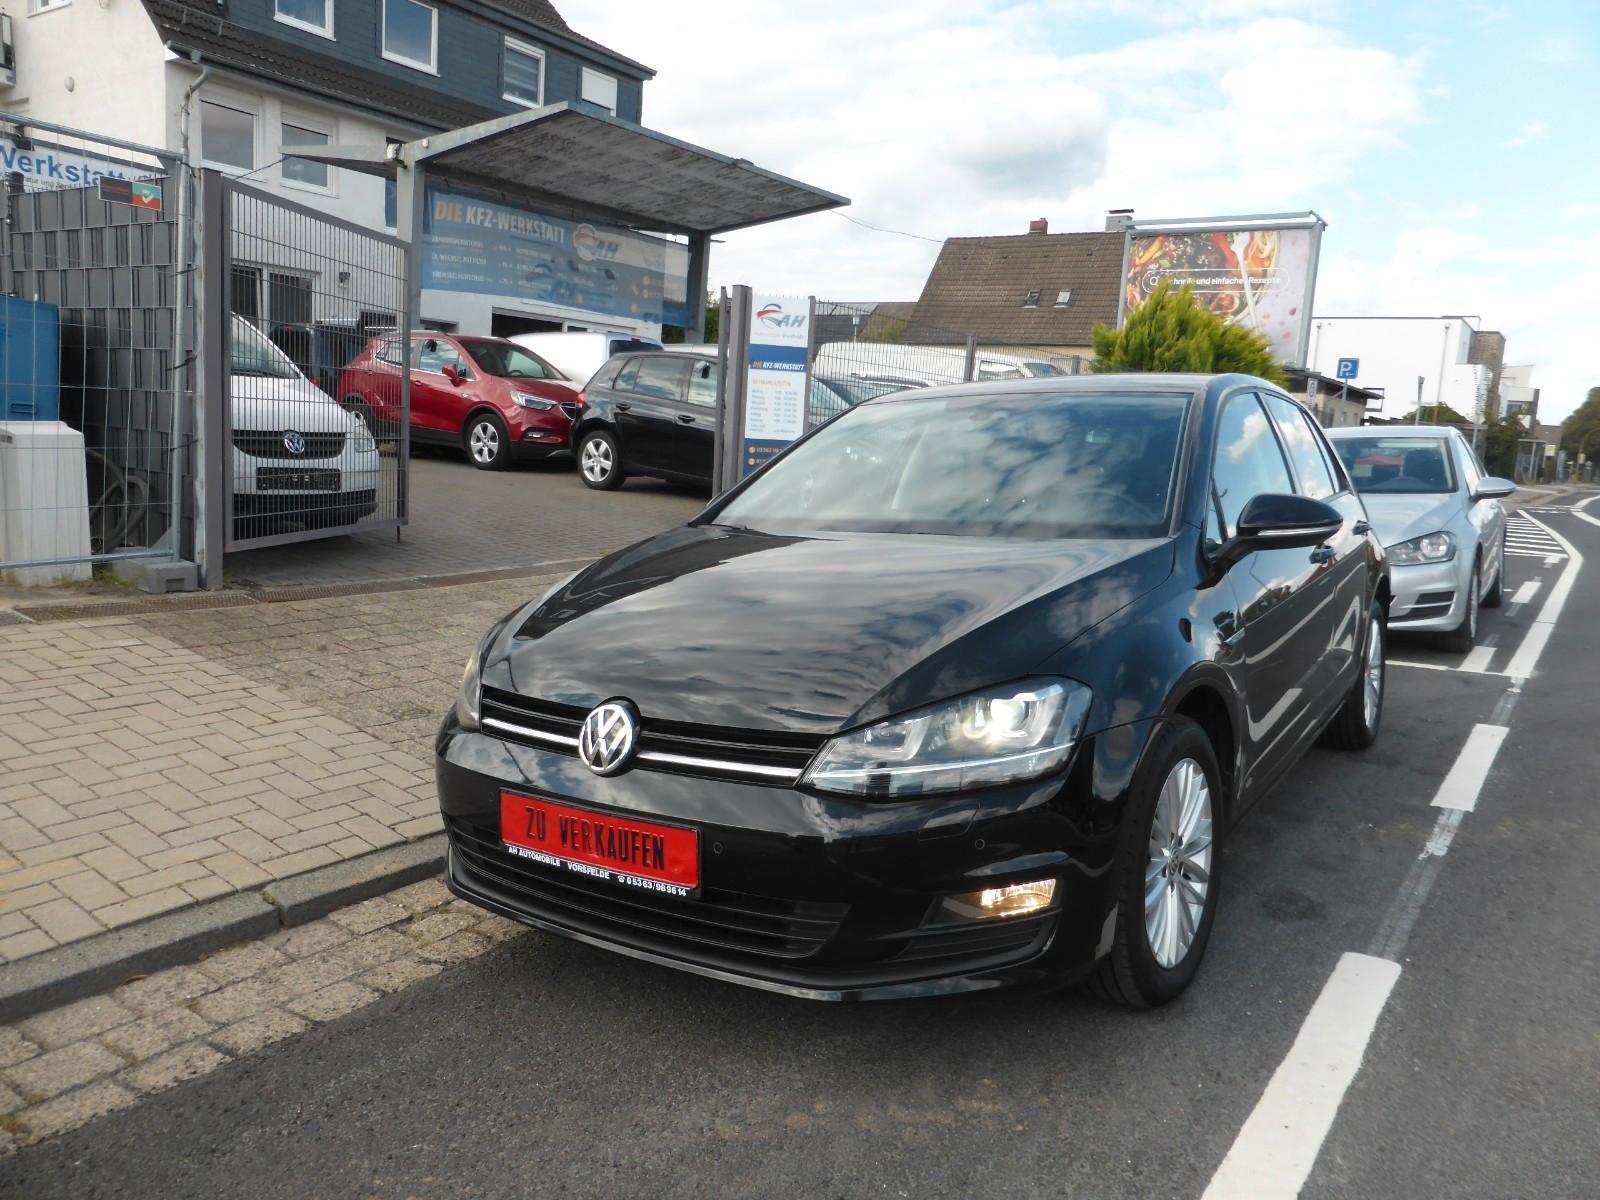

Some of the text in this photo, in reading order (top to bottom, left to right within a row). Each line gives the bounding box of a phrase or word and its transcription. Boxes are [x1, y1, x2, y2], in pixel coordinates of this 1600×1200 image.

[434, 201, 464, 224] DIE
[466, 205, 565, 244] KFZ-WERKSTATT
[779, 314, 806, 328] AH
[1339, 361, 1352, 377] P
[525, 805, 665, 871] ZU VERKAUFEN
[508, 846, 518, 855] AH
[519, 848, 561, 867] AUTOMOBILE
[567, 861, 610, 880] VORSFELDE
